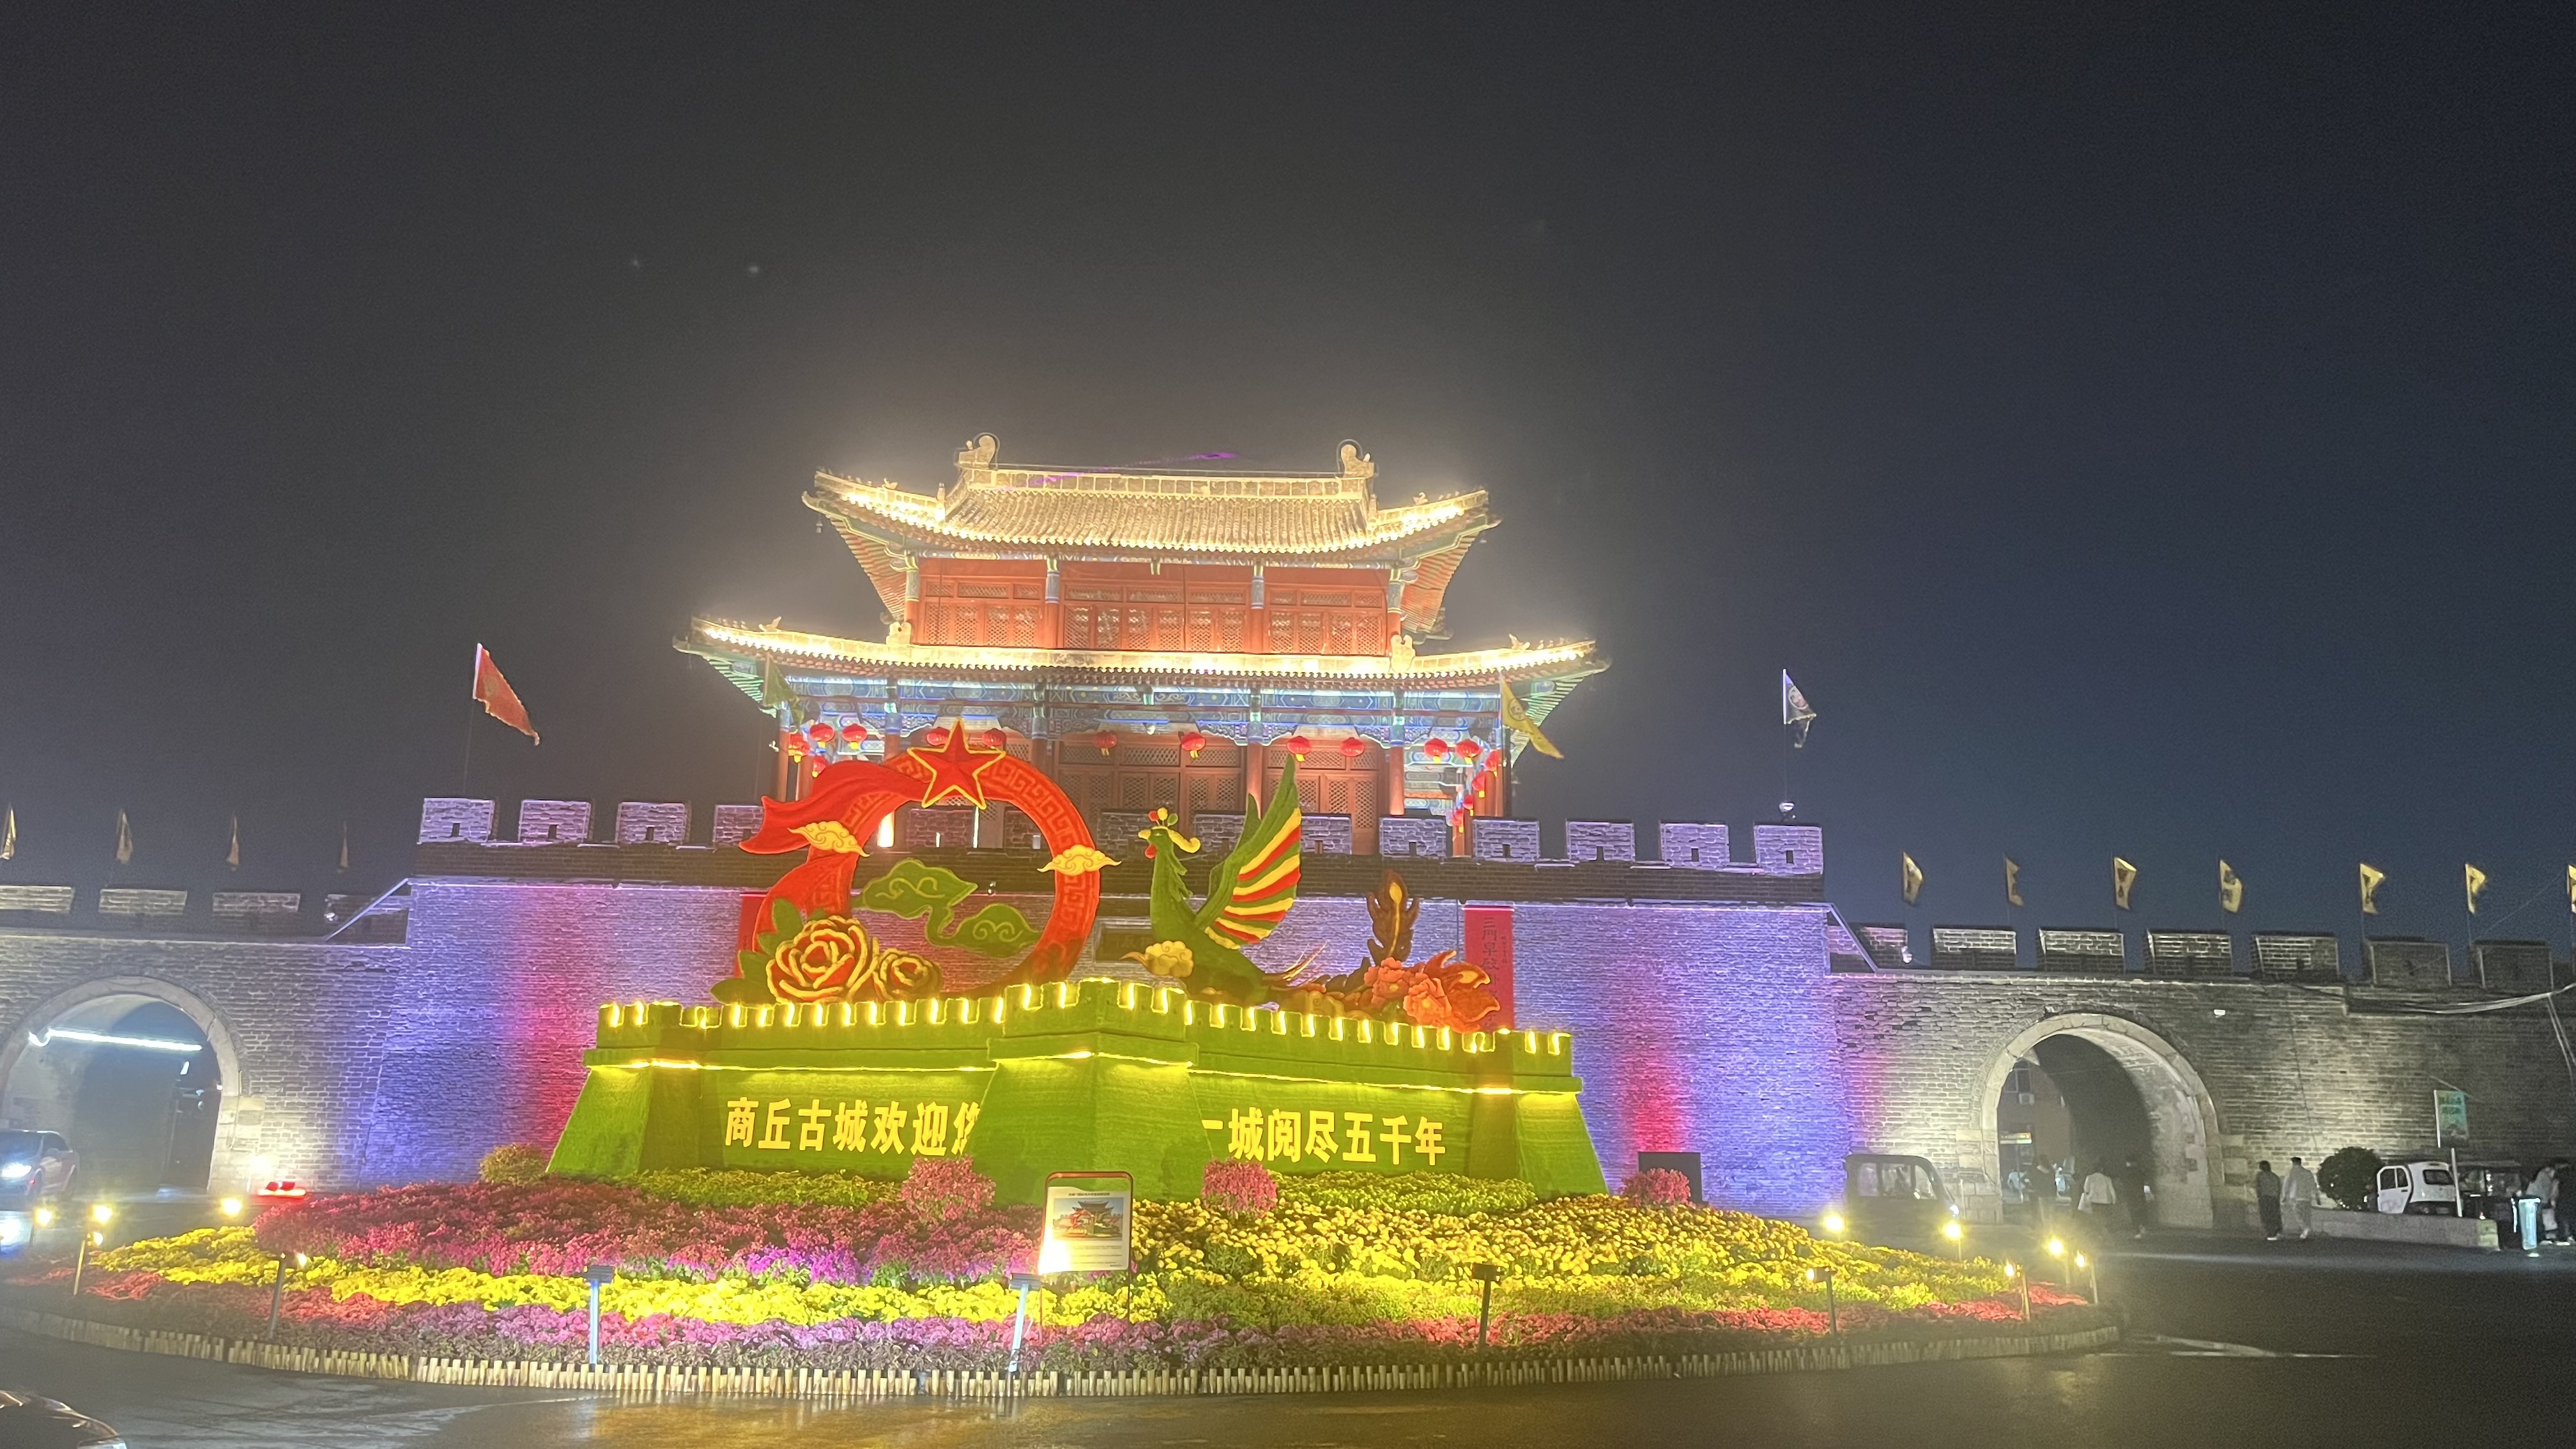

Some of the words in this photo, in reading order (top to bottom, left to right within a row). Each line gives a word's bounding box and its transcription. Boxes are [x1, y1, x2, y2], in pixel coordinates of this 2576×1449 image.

[725, 1096, 981, 1156] 商丘古城欢迎您
[1201, 1107, 1446, 1166] 一城阅尽五千年
